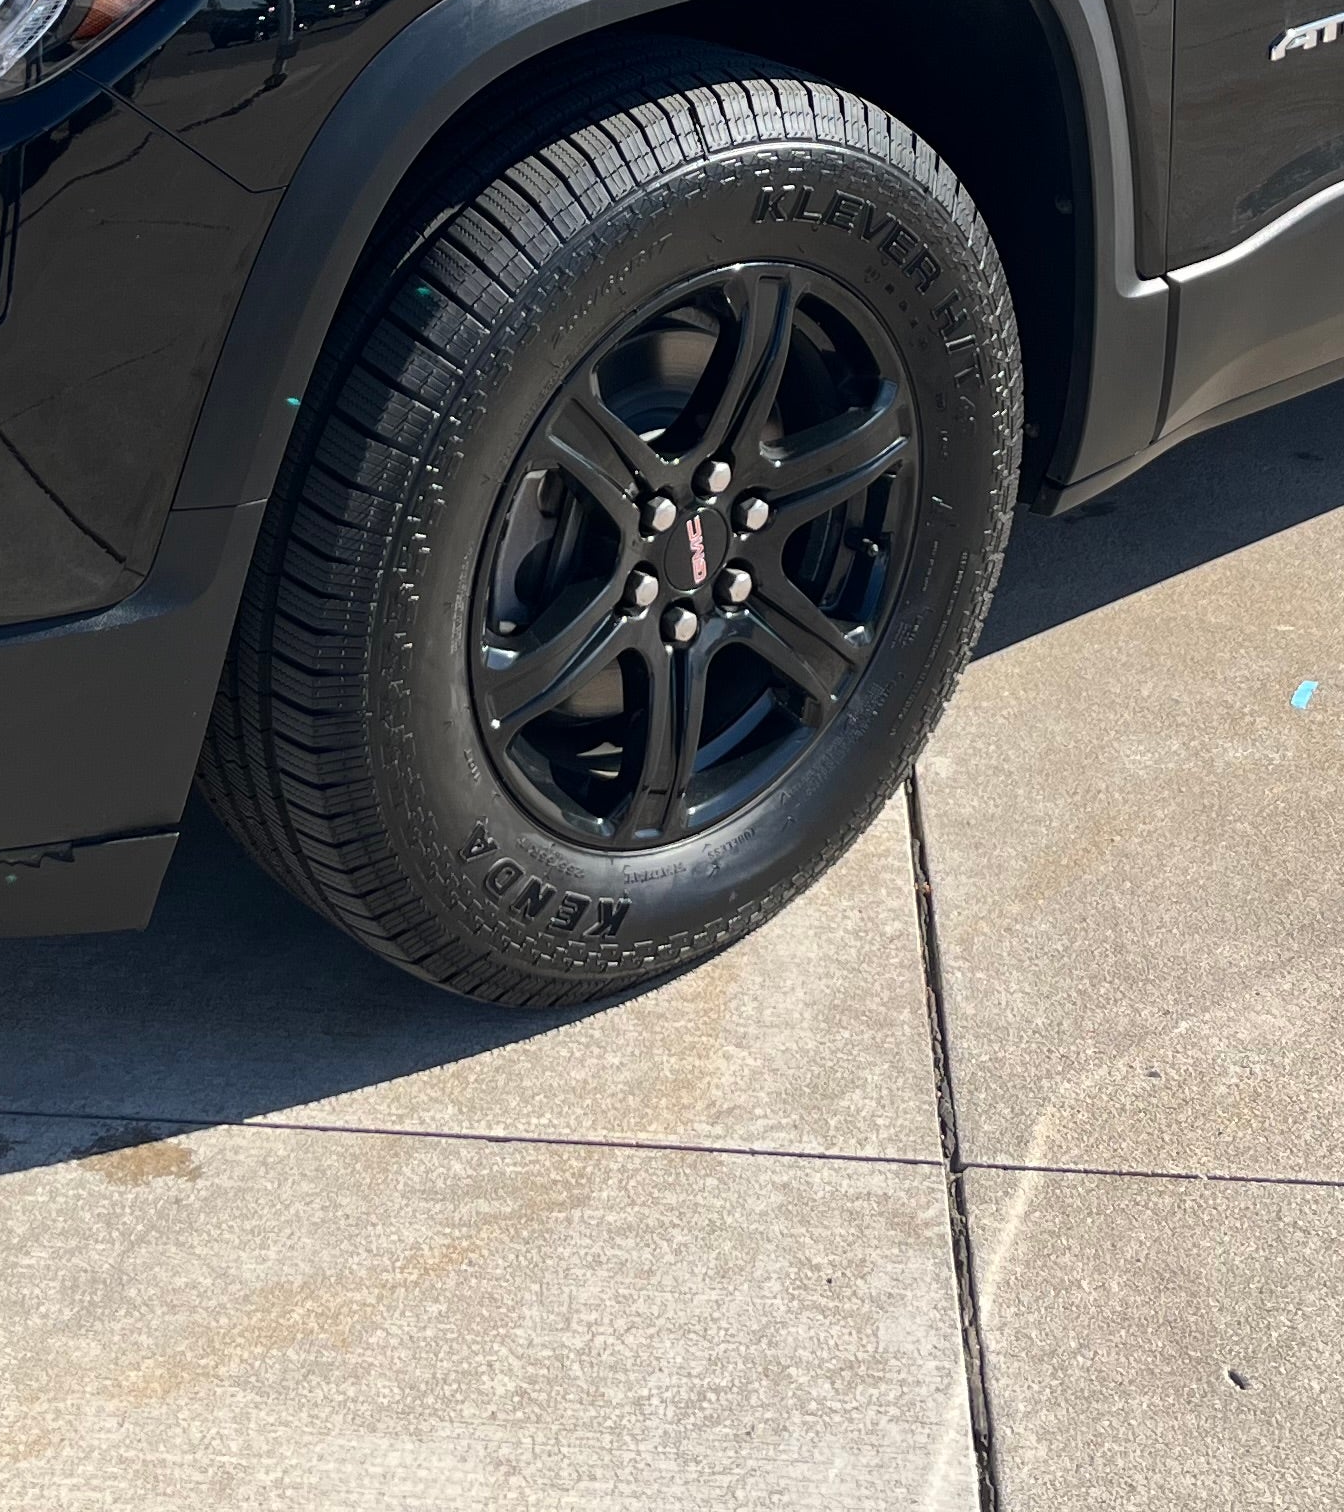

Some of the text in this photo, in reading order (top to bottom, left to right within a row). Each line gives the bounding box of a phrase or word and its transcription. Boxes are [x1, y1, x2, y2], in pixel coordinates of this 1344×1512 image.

[752, 184, 943, 295] KLEVER
[686, 514, 707, 584] GMC
[459, 816, 633, 938] KENDA
